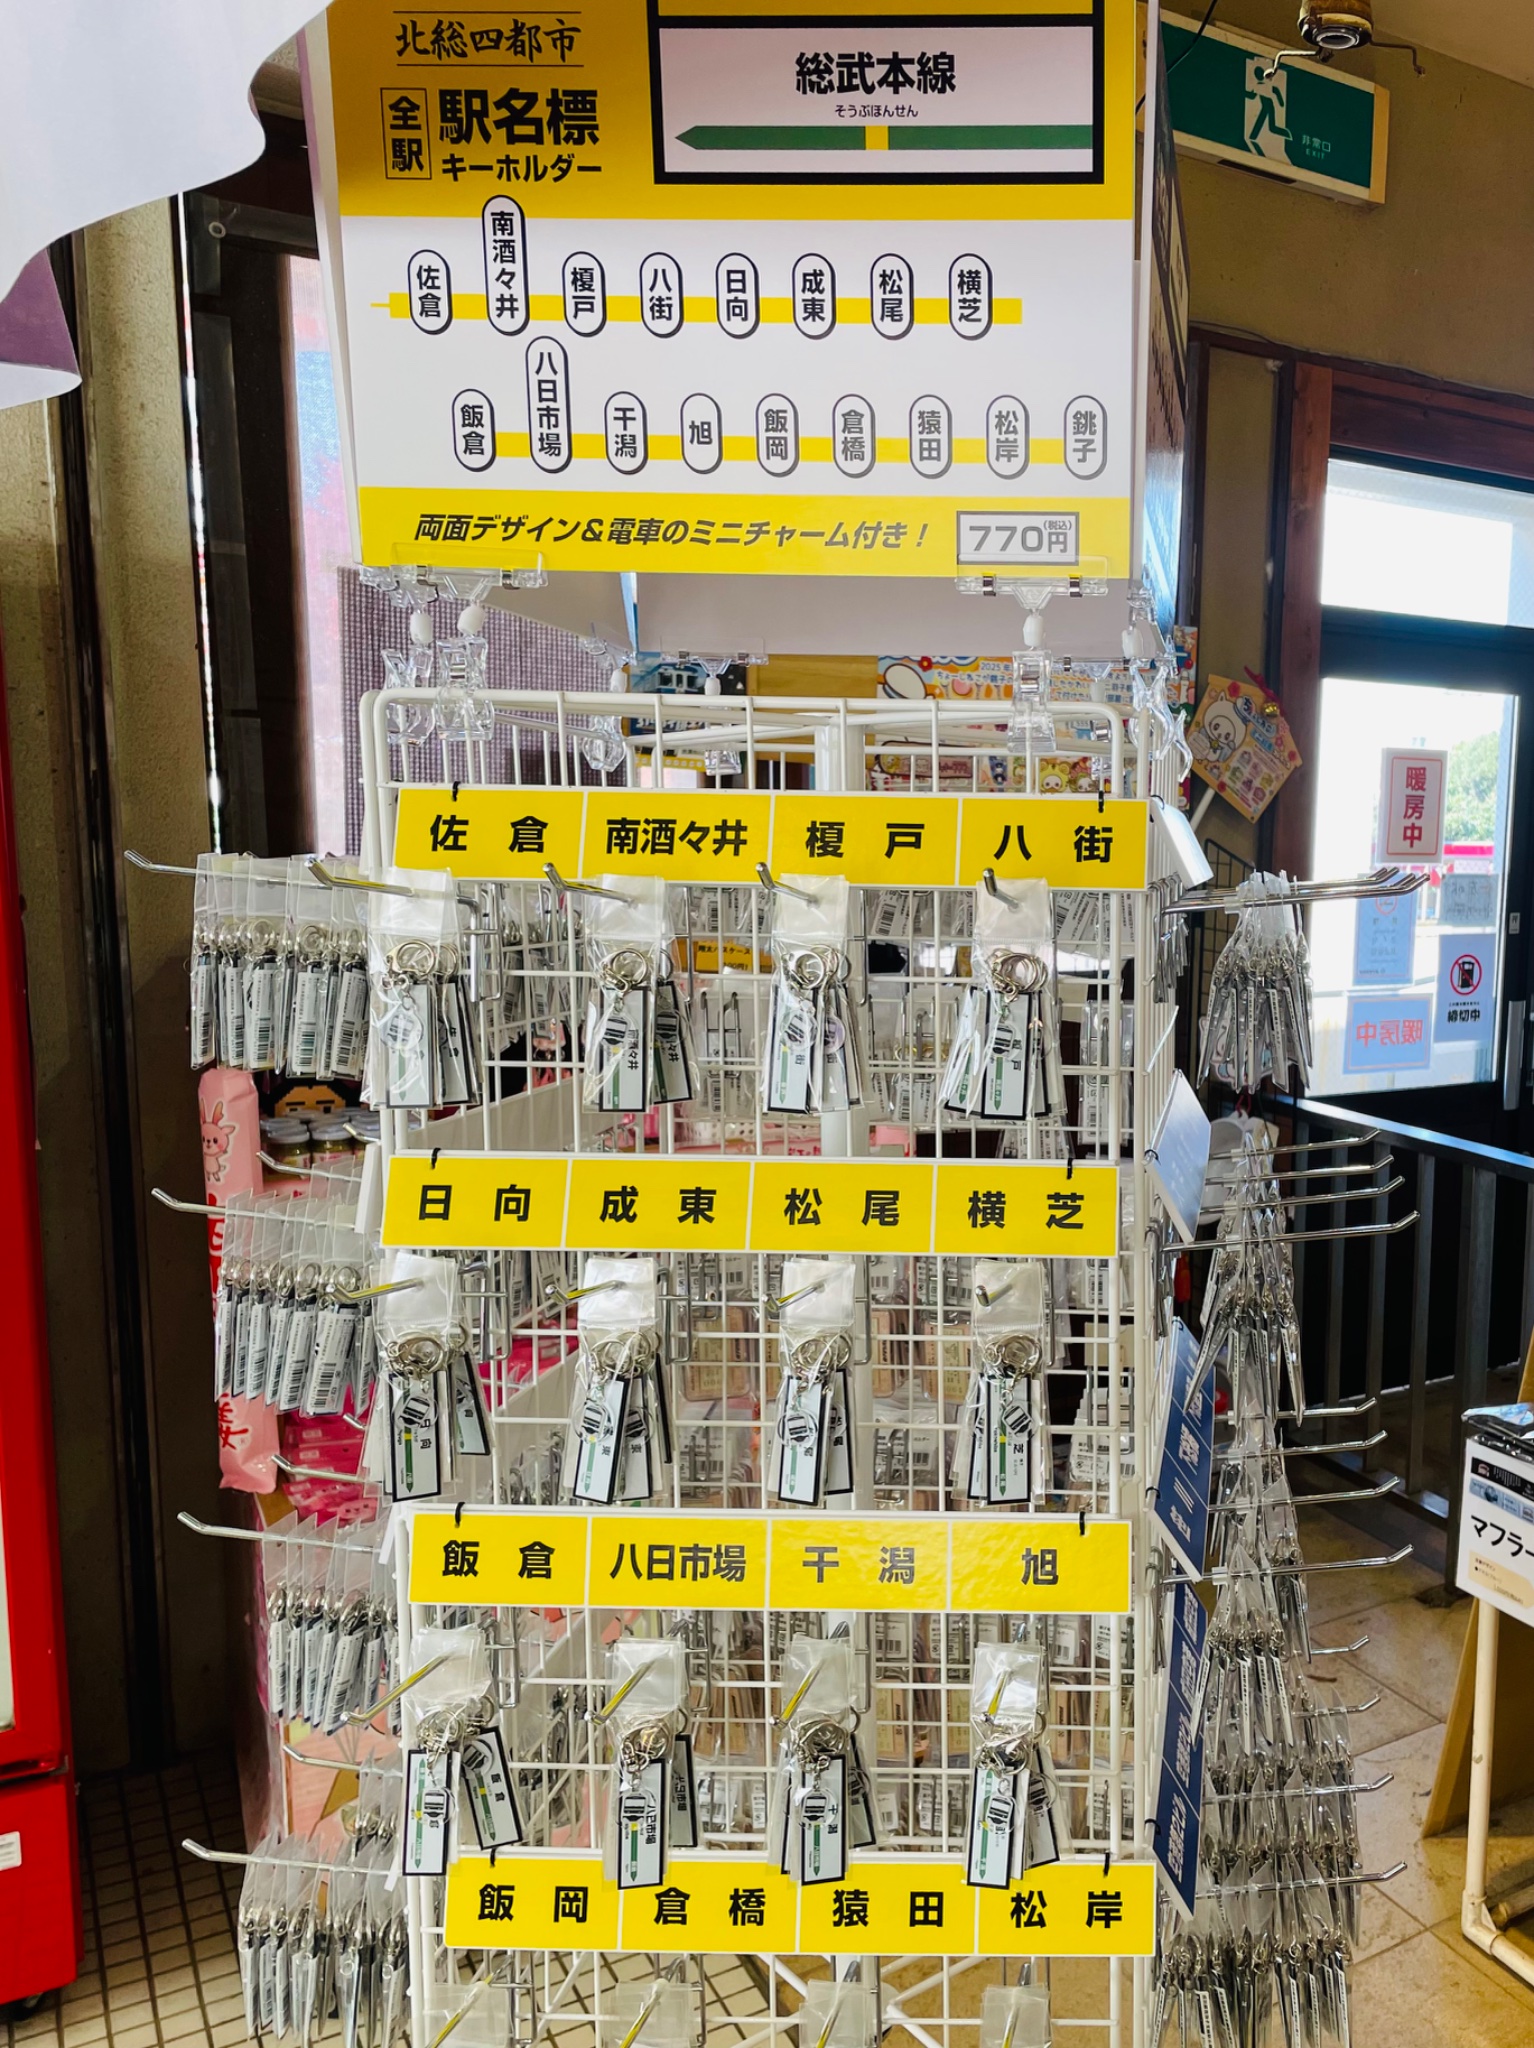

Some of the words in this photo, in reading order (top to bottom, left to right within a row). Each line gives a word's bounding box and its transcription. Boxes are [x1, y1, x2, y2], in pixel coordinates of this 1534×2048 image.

[395, 19, 582, 60] 北総四都市
[795, 51, 957, 95] 総武本線
[438, 87, 600, 146] 駅名標
[834, 104, 919, 119] そうぶほんせん
[390, 96, 422, 172] 全駅
[441, 153, 602, 184] キーホルダー
[490, 210, 519, 320] 南酒々井
[416, 265, 442, 319] 佐倉
[570, 266, 596, 320] 榎戸
[649, 267, 674, 321] 八街
[726, 269, 750, 322] 日向
[801, 269, 826, 323] 成東
[878, 269, 904, 323] 松尾
[957, 269, 982, 324] 横芝
[534, 351, 562, 458] 八日市場
[460, 403, 486, 457] 飯倉
[613, 407, 638, 459] 干潟
[688, 420, 713, 446] 旭
[763, 408, 789, 461] 飯岡
[841, 409, 866, 462] 倉橋
[917, 409, 943, 462] 猿田
[994, 409, 1019, 463] 松岸
[1072, 410, 1097, 463] 銚子
[1402, 766, 1427, 849] 暖房中
[429, 814, 549, 854] 佐倉
[606, 817, 748, 857] 南酒々井
[805, 820, 925, 859] 榎戸
[993, 824, 1114, 864] 八街
[418, 1184, 532, 1222] 日向
[599, 1185, 717, 1225] 成東
[783, 1187, 900, 1227] 松尾
[967, 1190, 1085, 1230] 横芝
[442, 1539, 556, 1580] 飯倉
[609, 1543, 747, 1582] 八日市場
[801, 1546, 915, 1585] 干潟
[1021, 1547, 1059, 1586] 旭
[478, 1884, 588, 1923] 飯岡
[654, 1888, 766, 1927] 倉橋
[833, 1890, 945, 1929] 猿田
[1010, 1890, 1123, 1930] 松岸
